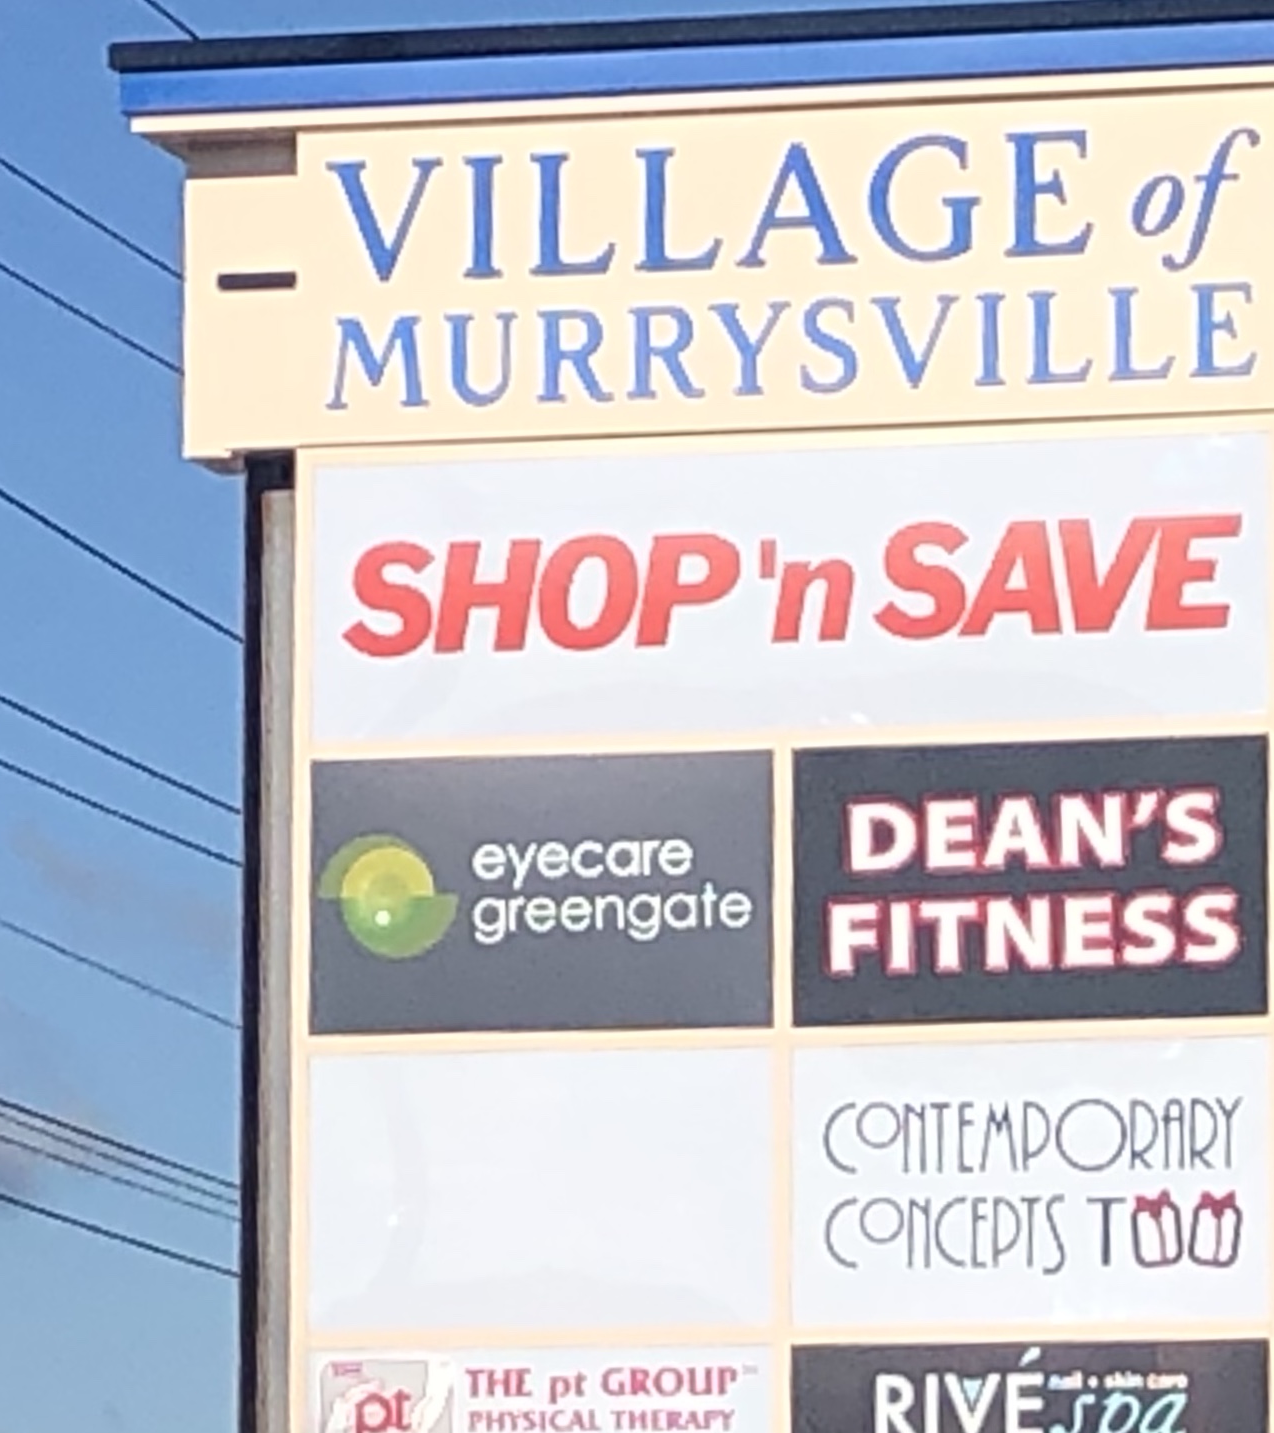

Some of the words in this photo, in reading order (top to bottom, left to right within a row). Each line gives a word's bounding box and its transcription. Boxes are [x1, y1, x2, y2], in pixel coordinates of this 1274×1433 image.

[325, 130, 1093, 282] VILLAGE
[1131, 128, 1260, 271] of
[326, 282, 1257, 410] MURRYSVILLE
[342, 533, 740, 657] SHOP
[759, 539, 854, 643] 'n
[873, 514, 1243, 640] SAVE
[472, 838, 693, 889] eyecare
[845, 788, 1222, 873] DEAN'S
[472, 881, 753, 945] greengate
[827, 891, 1242, 977] FITNESS
[823, 1096, 1243, 1174] CONTEMPORARY
[826, 1194, 1065, 1275] CONCEPTS
[465, 1367, 533, 1398] THE
[549, 1368, 587, 1404] pt
[600, 1366, 739, 1398] GROUP
[467, 1409, 602, 1433] PHYSICAL
[610, 1408, 735, 1432] THERAPY
